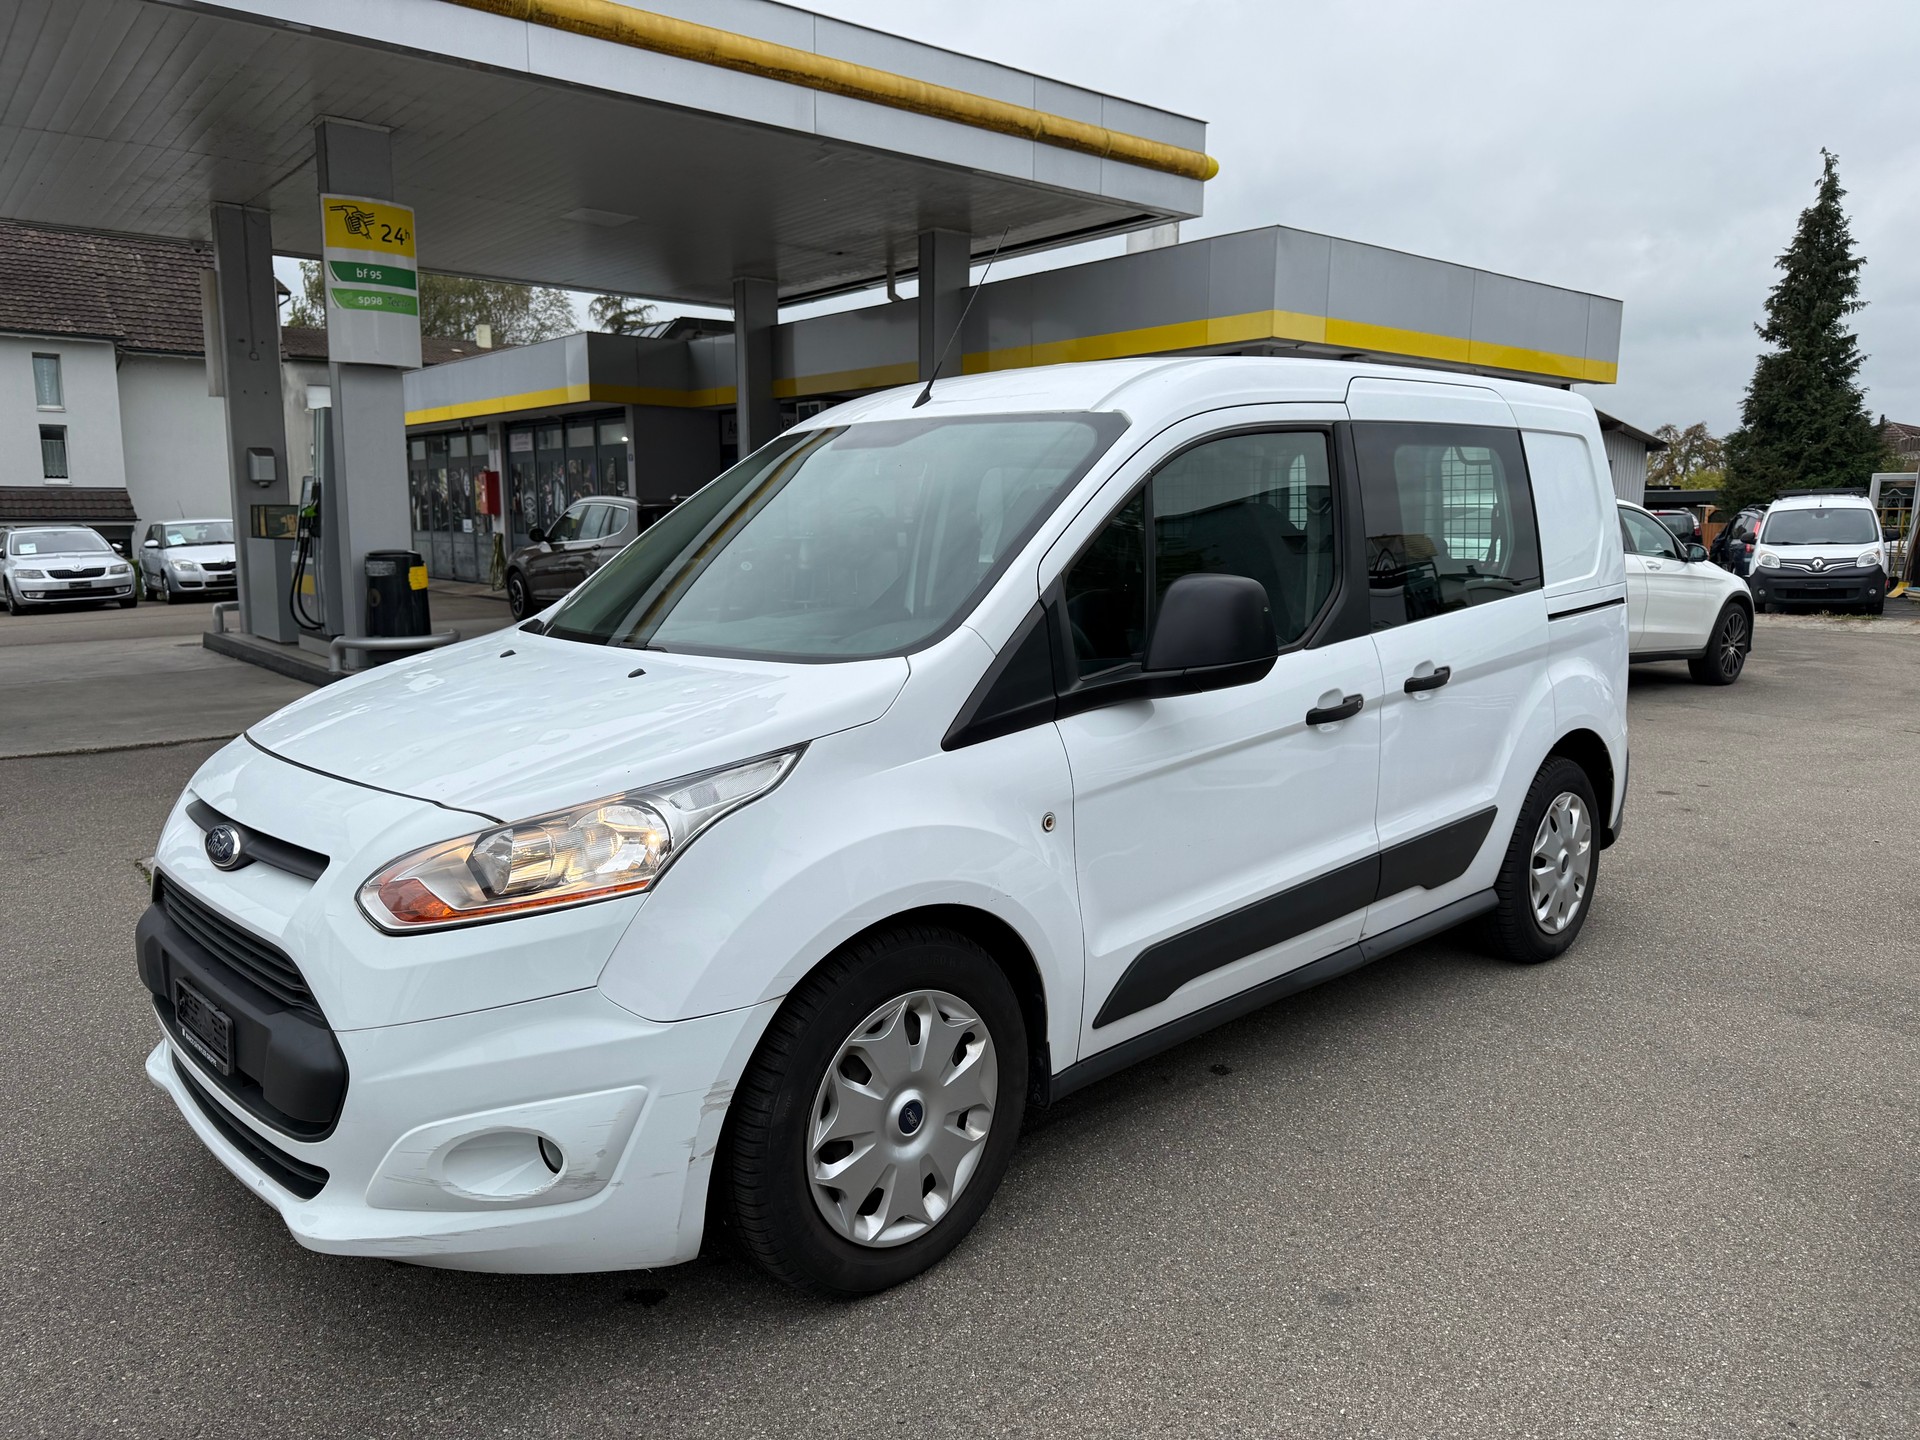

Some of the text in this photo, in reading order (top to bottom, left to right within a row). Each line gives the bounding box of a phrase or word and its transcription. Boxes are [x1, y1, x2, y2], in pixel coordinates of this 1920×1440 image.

[356, 267, 382, 280] bf 95
[358, 296, 383, 306] sp98
[207, 829, 228, 857] Ford
